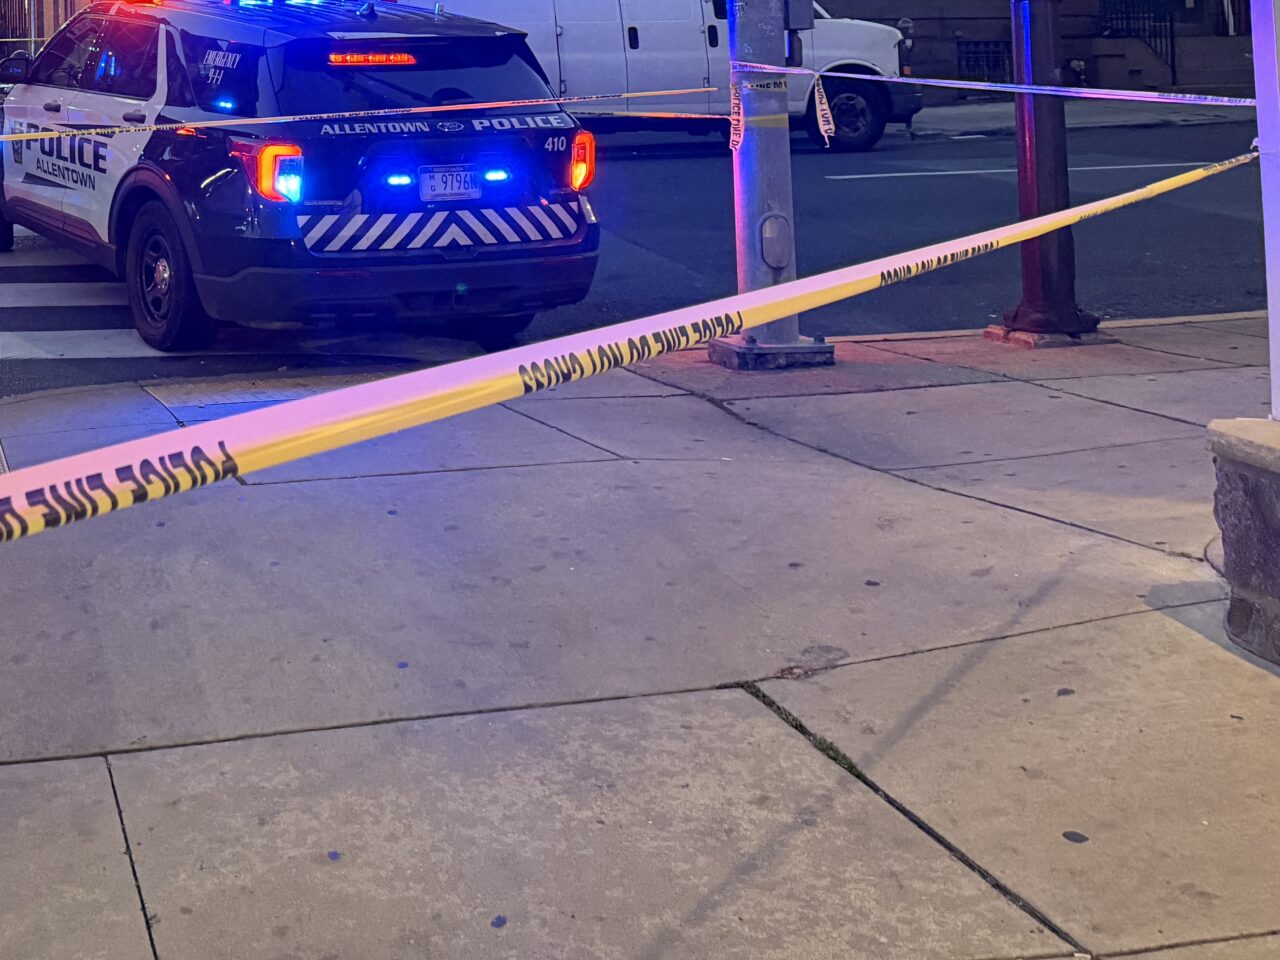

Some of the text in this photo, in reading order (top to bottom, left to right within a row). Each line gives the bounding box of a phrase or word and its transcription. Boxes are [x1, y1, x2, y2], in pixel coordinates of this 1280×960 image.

[203, 49, 242, 69] EMERGENCY
[320, 120, 430, 136] ALLENTOWN
[470, 115, 565, 131] POLICE
[544, 136, 567, 152] 410
[36, 157, 96, 191] ALLENTOWN
[115, 440, 240, 503] POLICE
